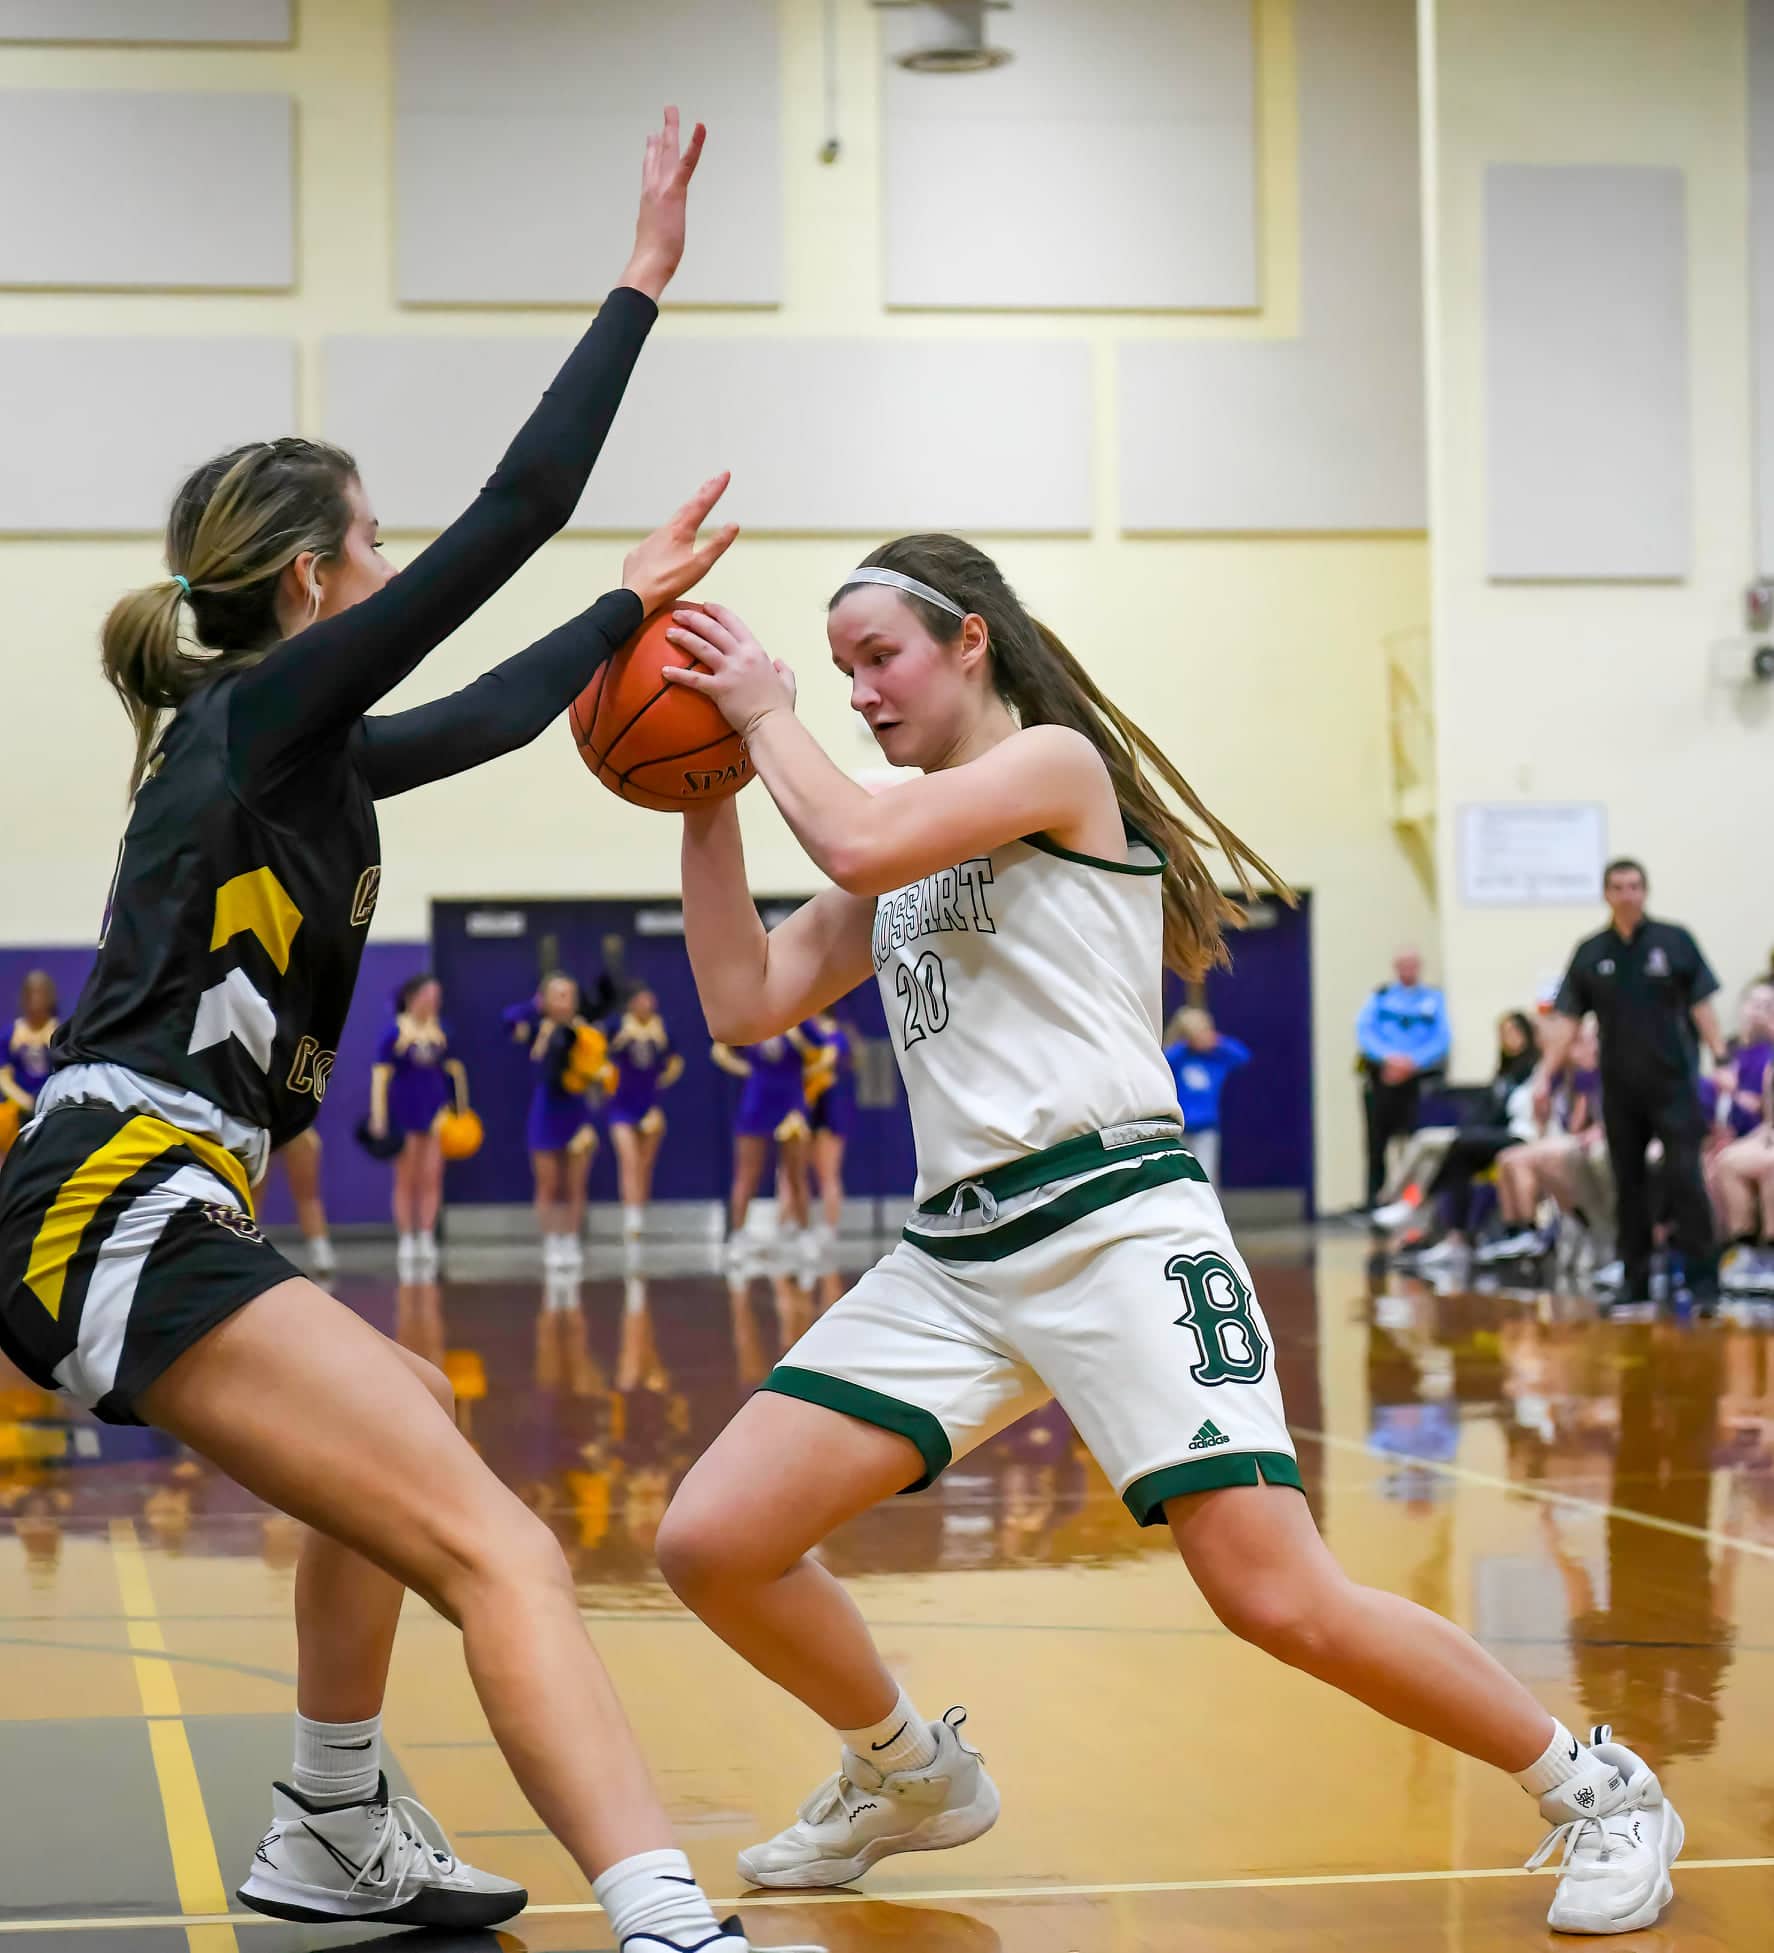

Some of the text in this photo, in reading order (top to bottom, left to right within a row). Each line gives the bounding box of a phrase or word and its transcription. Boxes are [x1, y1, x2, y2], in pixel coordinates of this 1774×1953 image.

[896, 950, 949, 1051] 20
[1163, 1250, 1269, 1387] B
[1188, 1434, 1231, 1450] adidas
